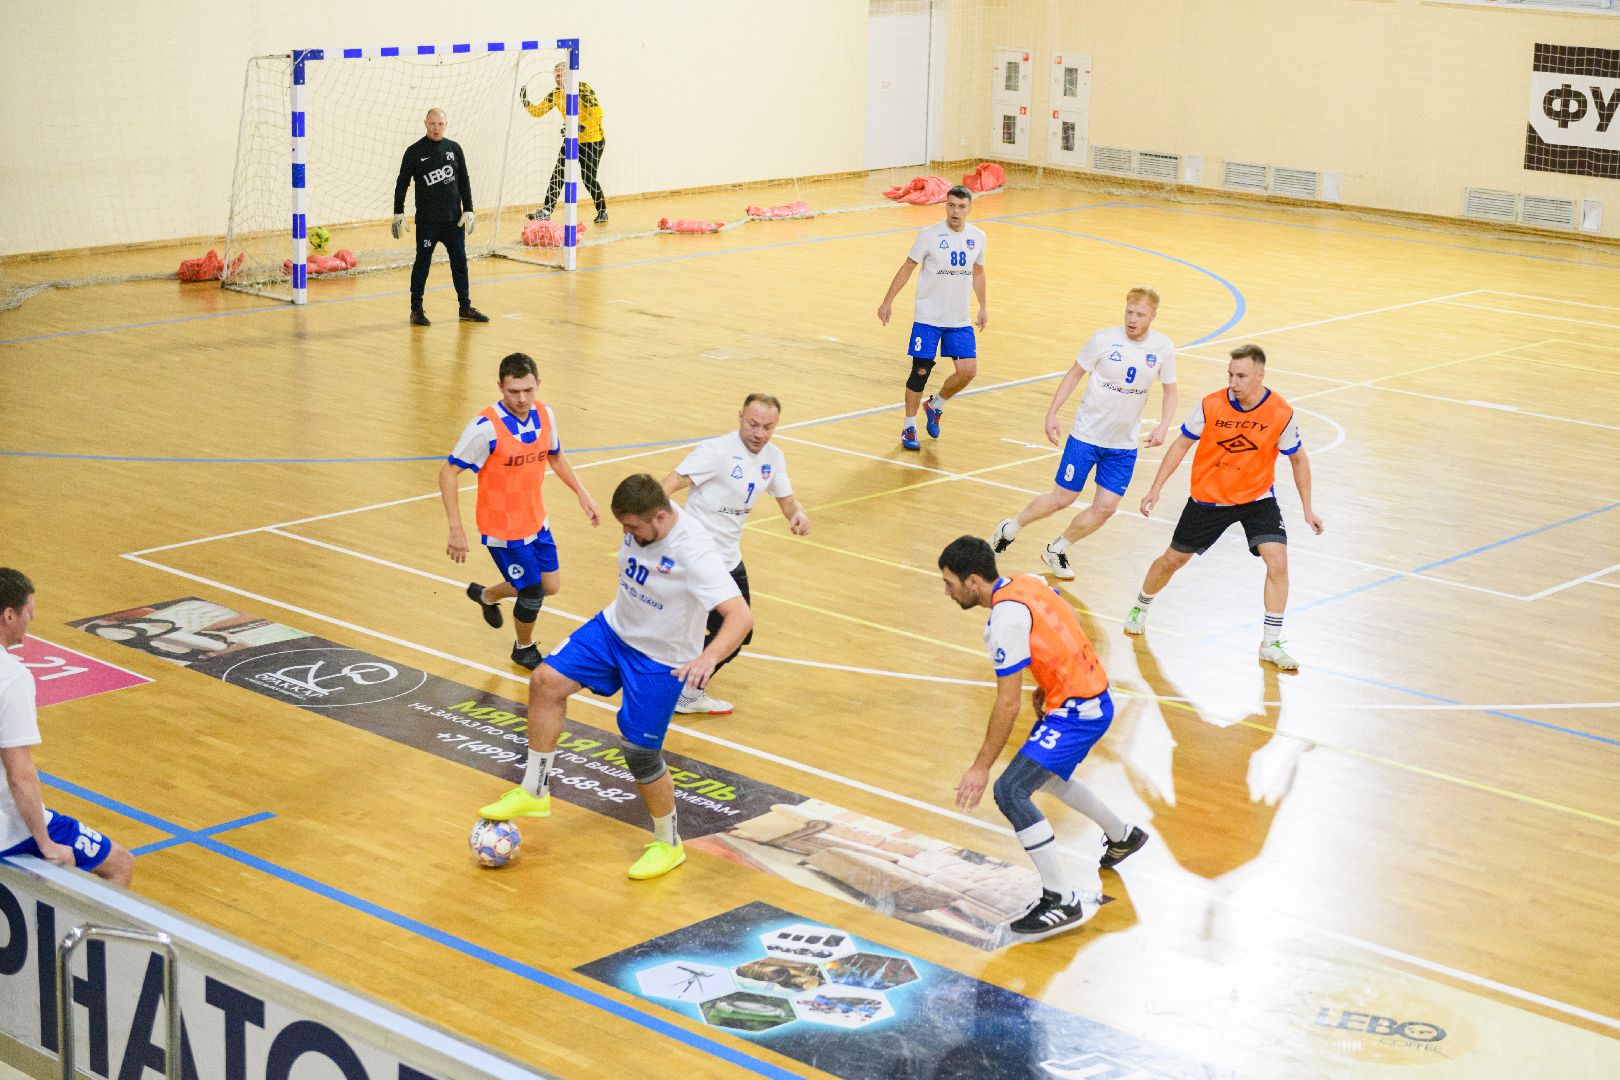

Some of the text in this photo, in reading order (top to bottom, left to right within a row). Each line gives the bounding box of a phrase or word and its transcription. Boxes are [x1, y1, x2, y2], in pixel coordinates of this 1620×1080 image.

[1542, 83, 1620, 132] ФУ
[423, 164, 454, 187] LEBO
[950, 251, 967, 267] 88
[1125, 366, 1137, 384] 9
[1063, 463, 1075, 482] 9
[743, 482, 756, 504] 7
[625, 556, 650, 586] 30
[408, 702, 433, 713] НА
[430, 709, 481, 728] ЗАКАЗ
[476, 725, 505, 736] ПО
[558, 752, 588, 764] ПО
[584, 761, 636, 782] ВАШИ
[437, 732, 471, 742] +7
[456, 740, 522, 763] (499)
[447, 700, 602, 753] МЯГАЯ
[590, 747, 737, 801] МЕЛЬ
[1029, 724, 1062, 750] 33
[1314, 1007, 1447, 1042] LEBO
